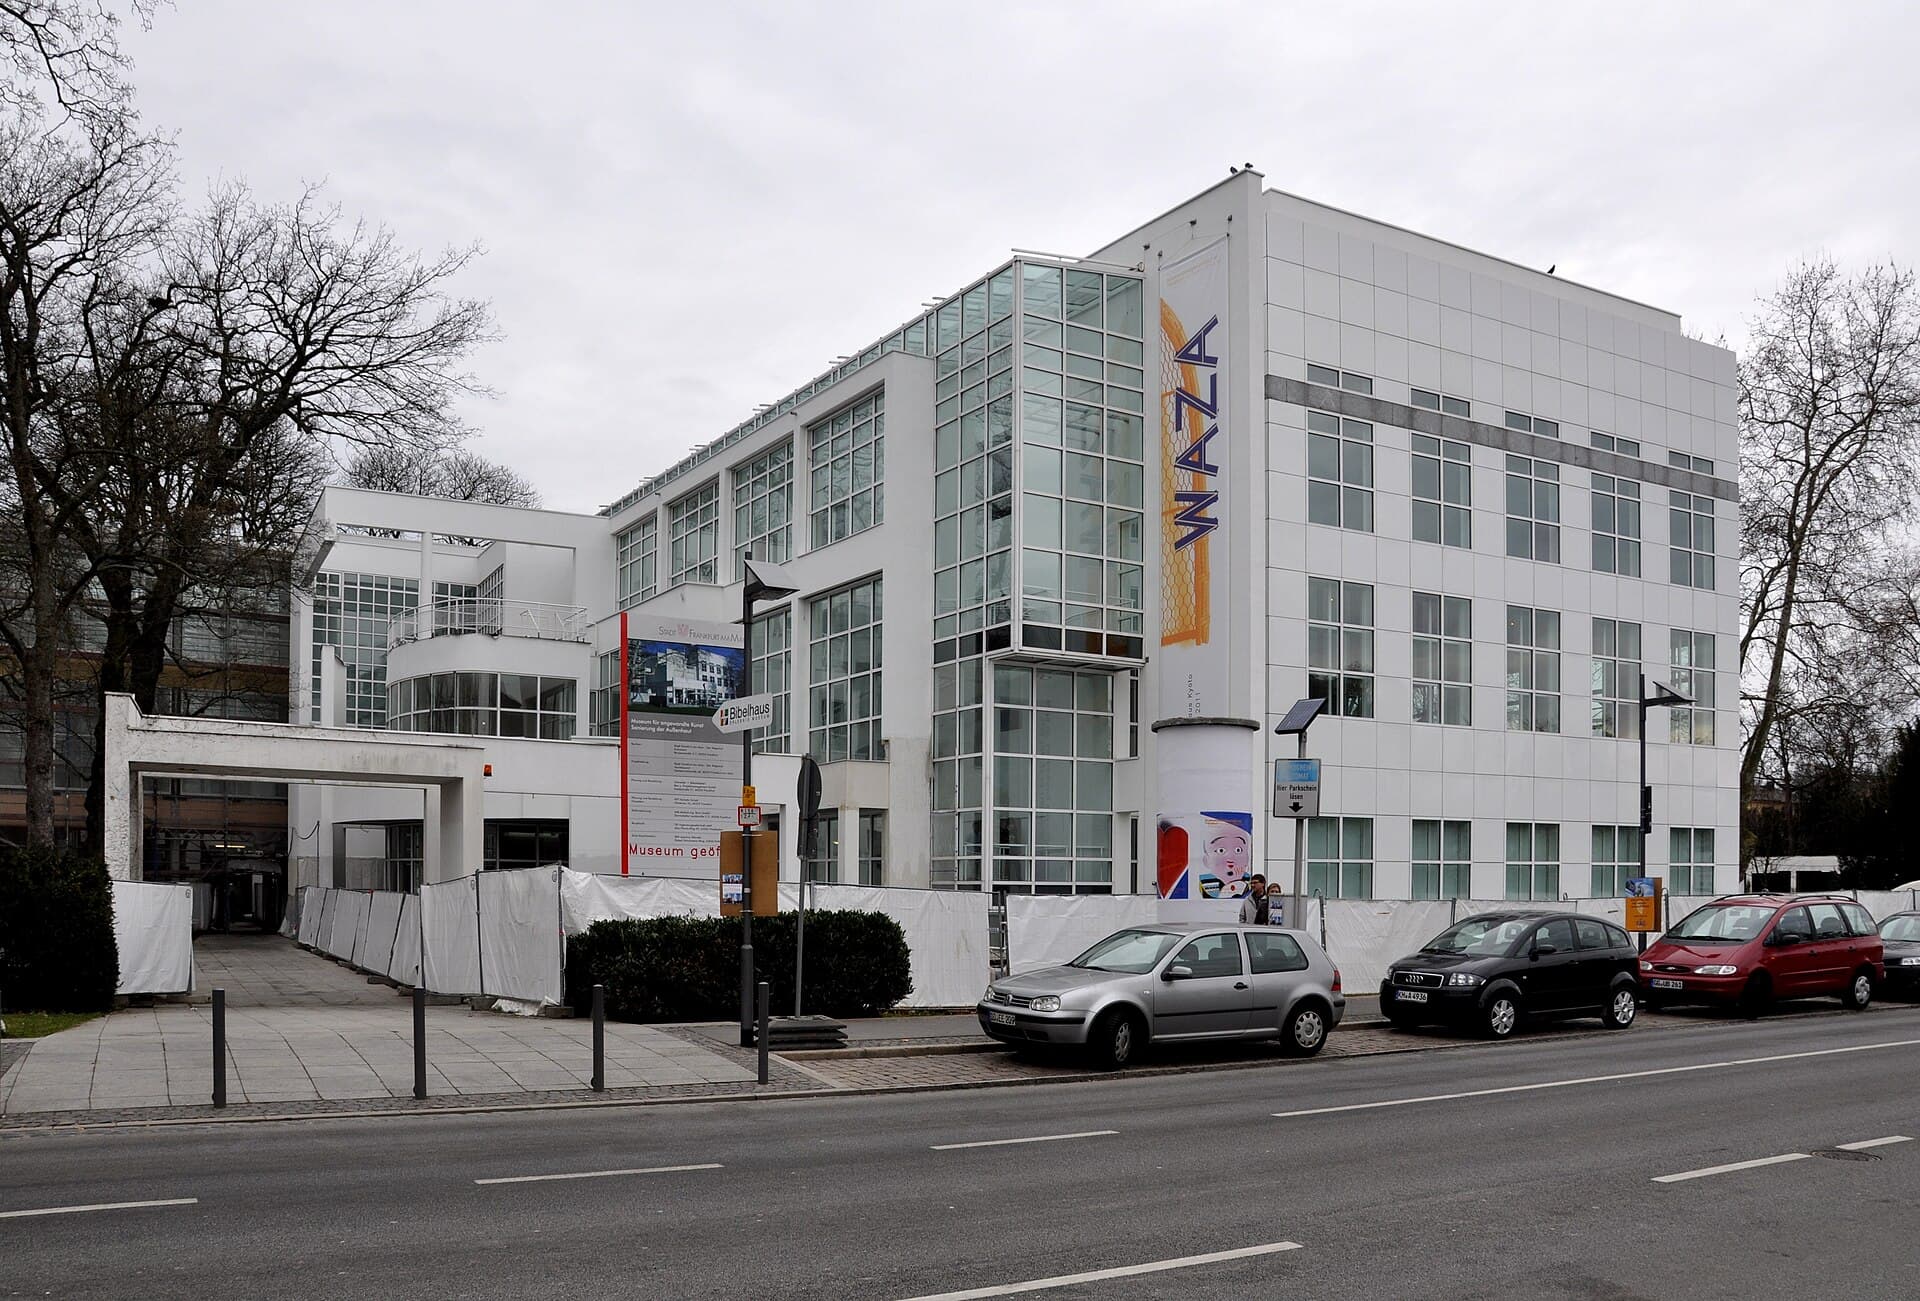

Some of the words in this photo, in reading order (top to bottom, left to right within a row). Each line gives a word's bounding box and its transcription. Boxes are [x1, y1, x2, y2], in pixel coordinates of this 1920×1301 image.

[1174, 314, 1219, 551] WAZA
[729, 703, 770, 720] Bibelhaus
[629, 843, 684, 856] Museum
[690, 845, 720, 859] geöf
